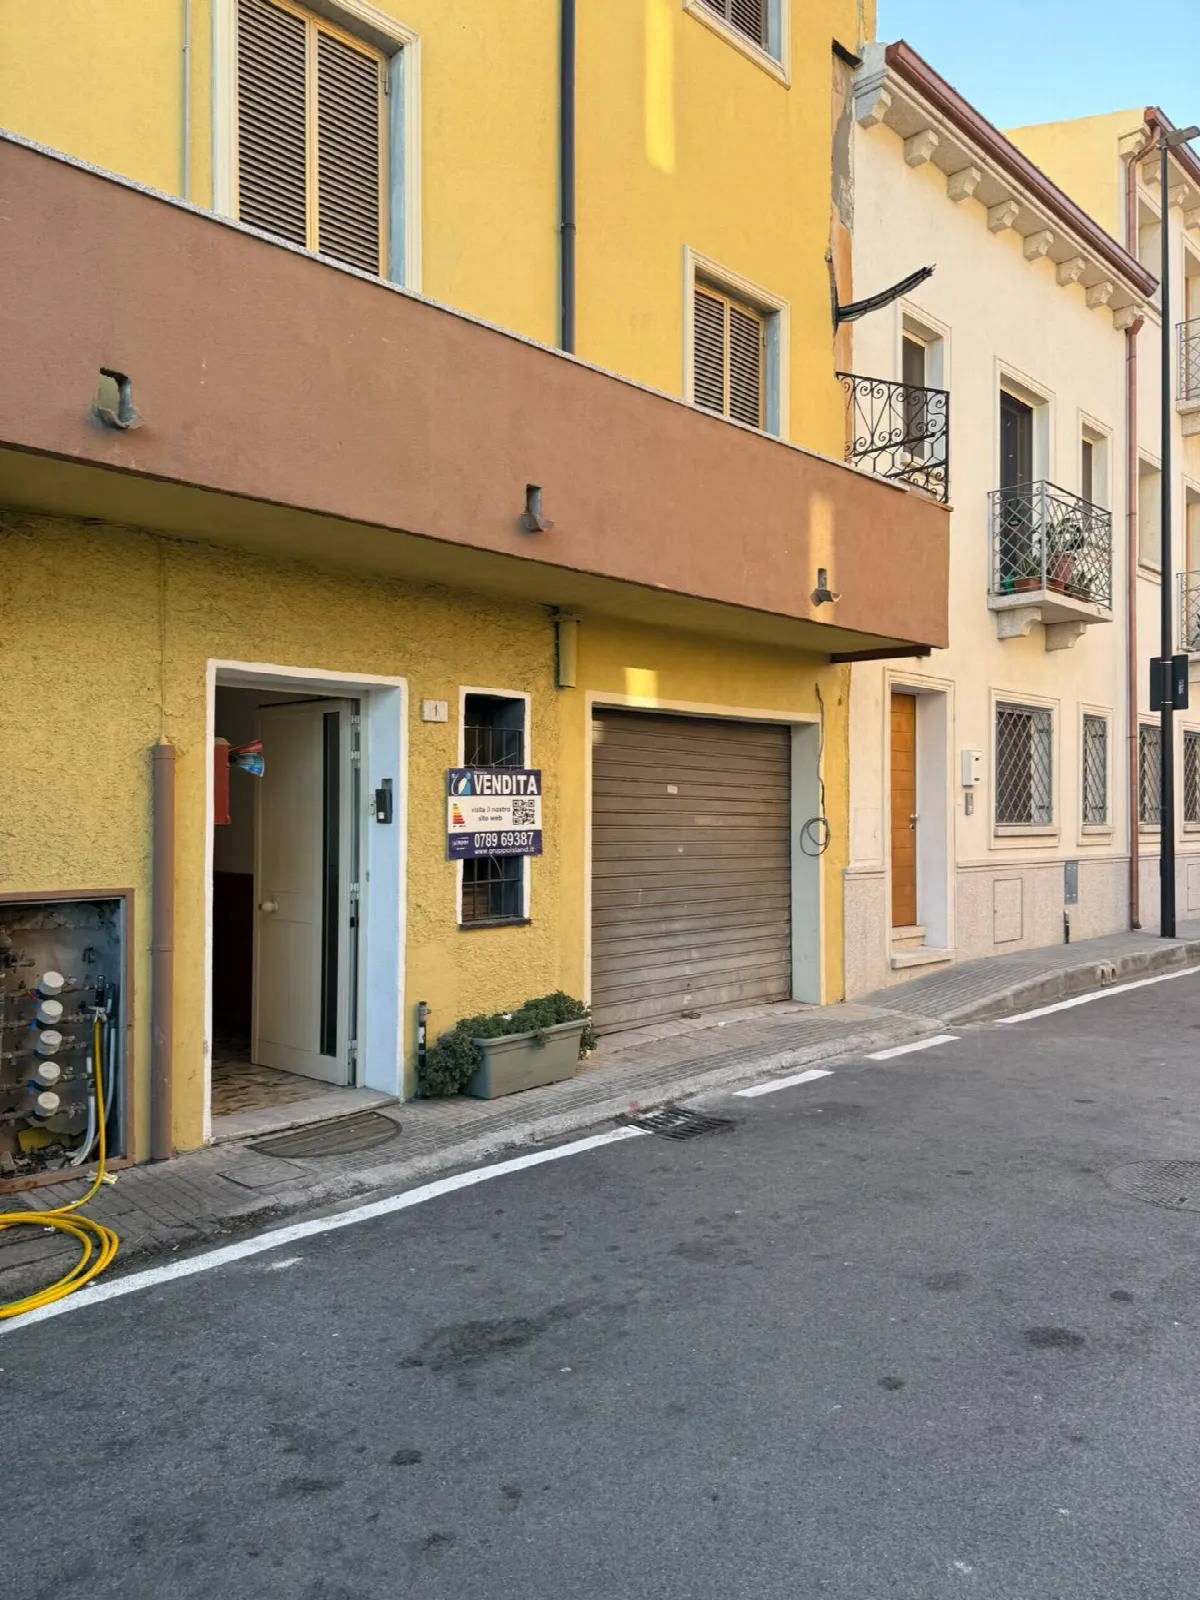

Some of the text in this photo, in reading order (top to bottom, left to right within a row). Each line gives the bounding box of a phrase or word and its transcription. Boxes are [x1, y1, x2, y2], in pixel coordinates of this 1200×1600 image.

[473, 774, 538, 795] VENDITA
[474, 833, 498, 848] 0789
[500, 832, 534, 847] 69387
[474, 846, 535, 855] www.gruppoisland.it
